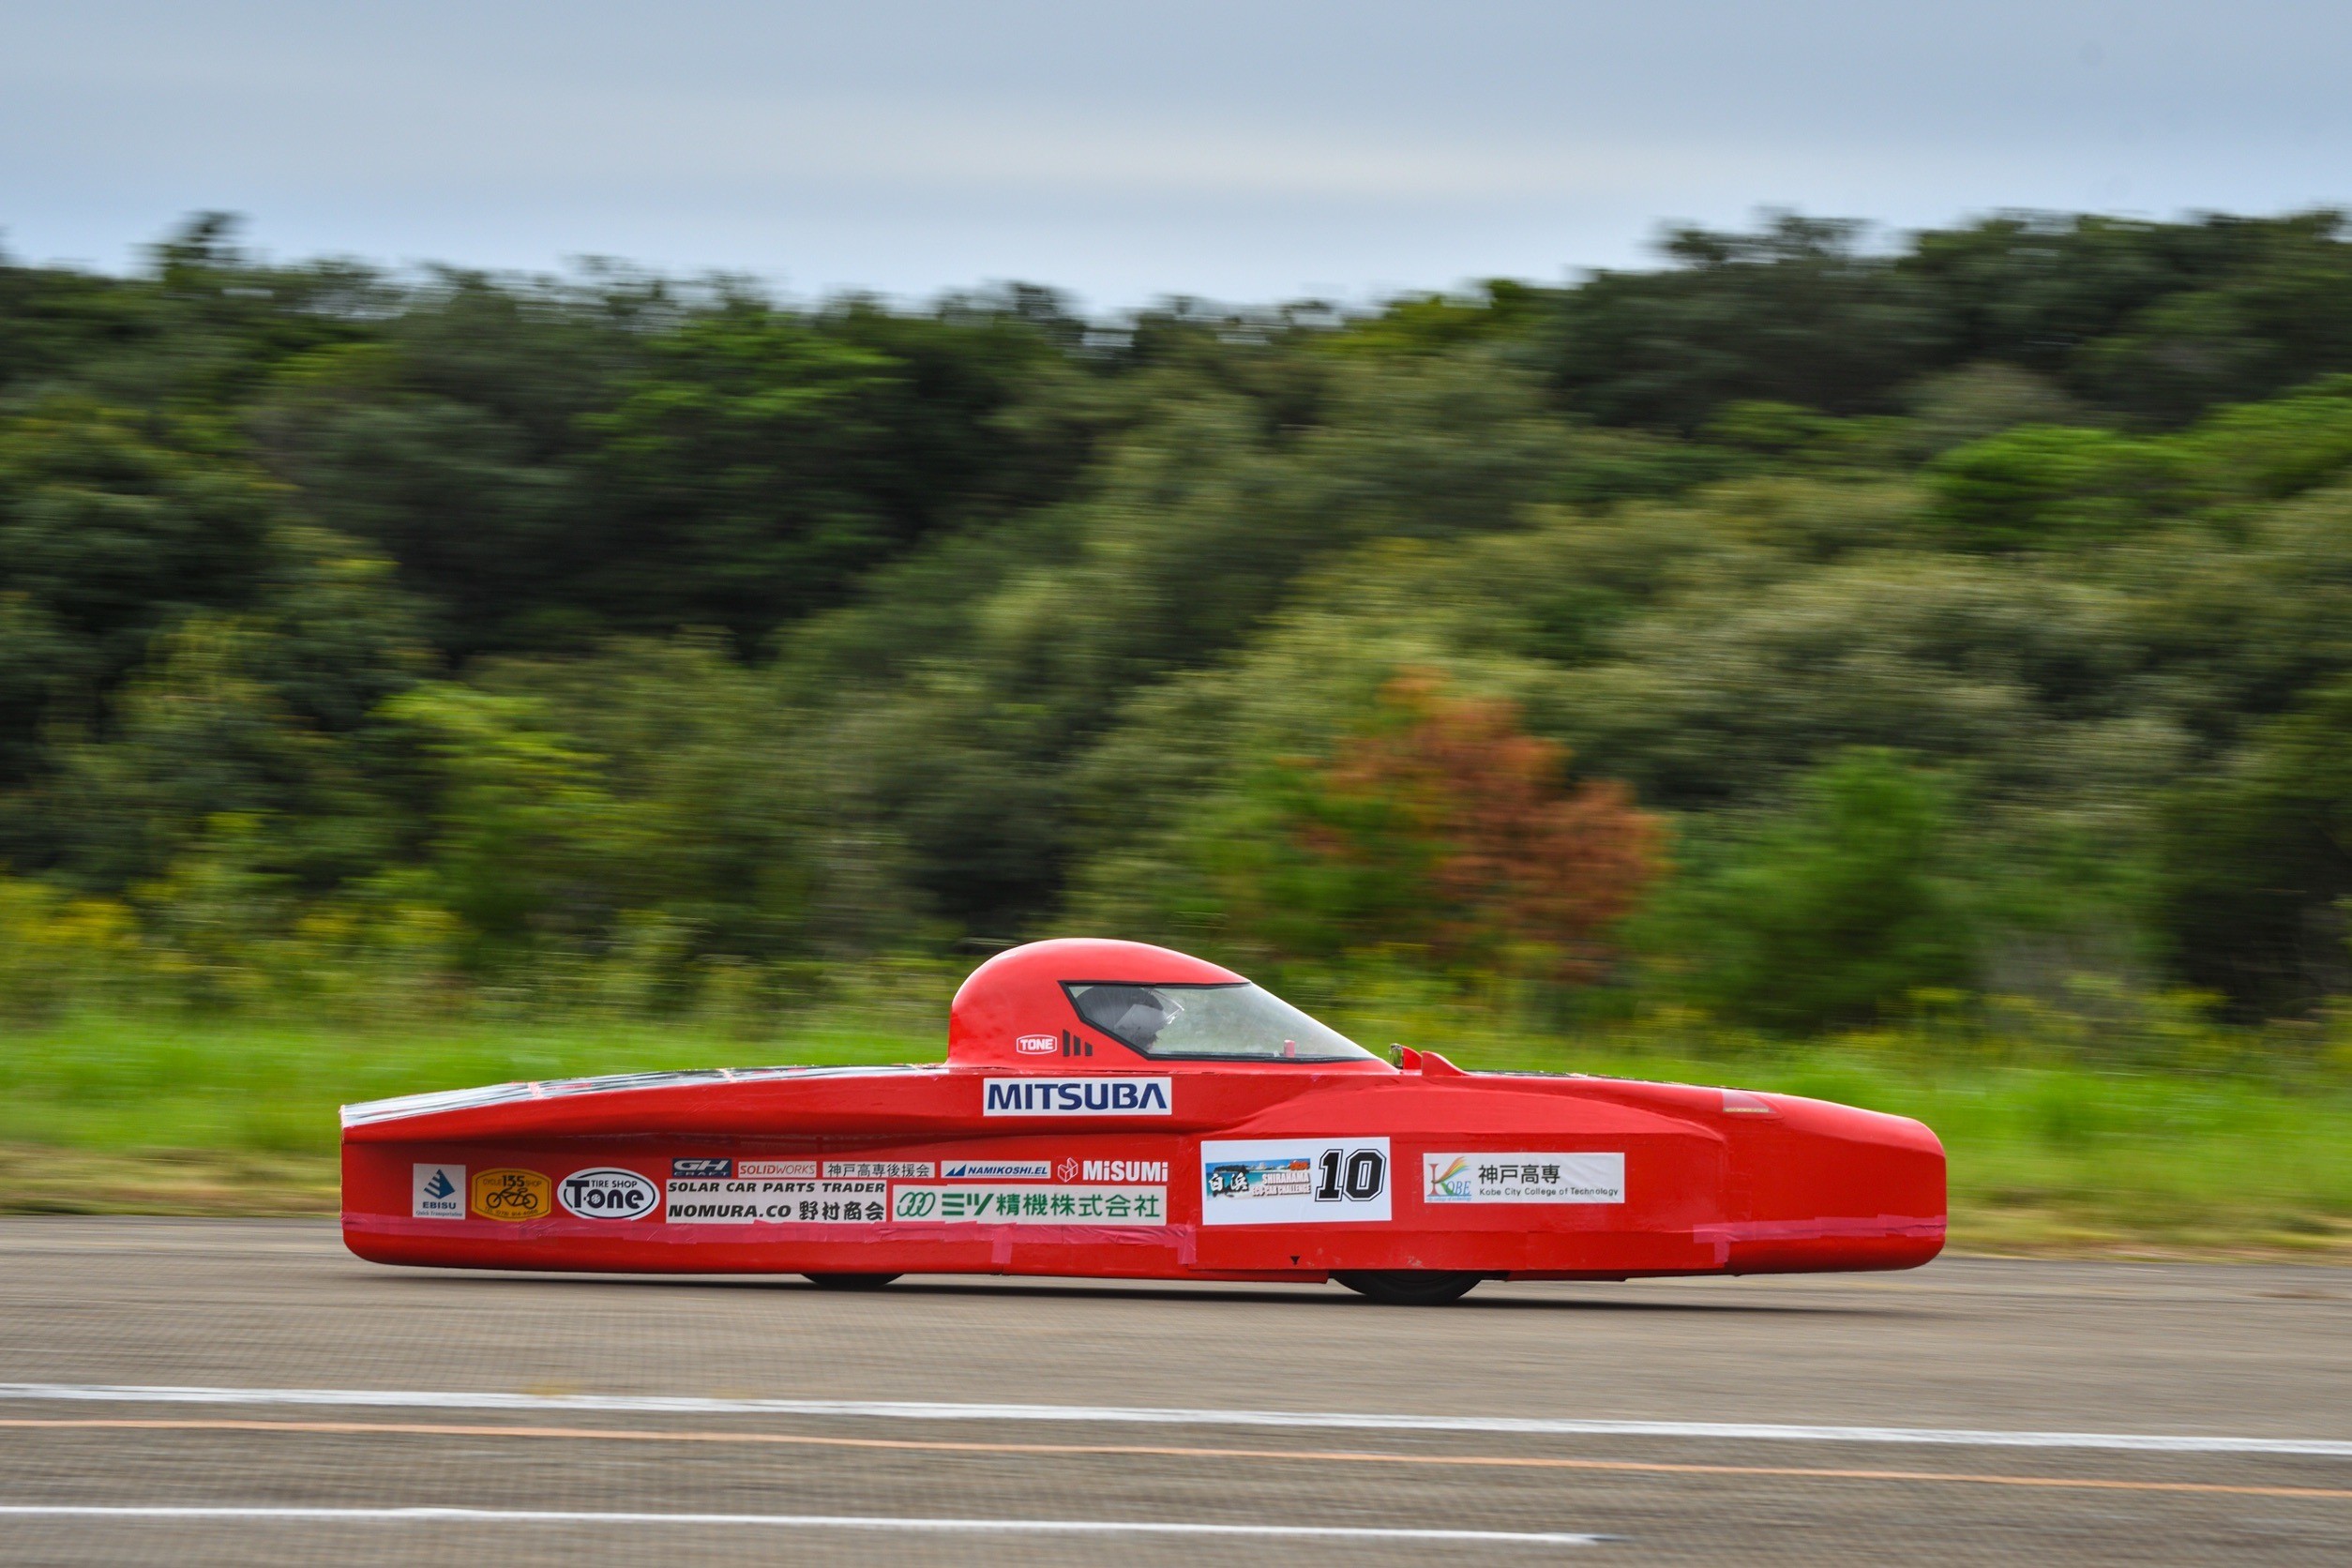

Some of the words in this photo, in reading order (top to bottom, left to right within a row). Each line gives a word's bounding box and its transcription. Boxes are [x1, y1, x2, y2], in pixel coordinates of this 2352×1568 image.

[1019, 1038, 1054, 1050] TONE
[988, 1082, 1167, 1110] MITSUBA
[673, 1159, 729, 1170] GH
[739, 1164, 815, 1175] SOLIDWORKS
[827, 1163, 930, 1178] 神戸高専後援会
[968, 1166, 1048, 1175] NAMIKOSHI.EL
[502, 1174, 525, 1187] 135
[1261, 1171, 1310, 1185] SHIRAHAMA
[1314, 1148, 1388, 1202] 10
[1478, 1164, 1560, 1184] 神戸高専
[591, 1180, 611, 1188] TIRE
[611, 1180, 638, 1188] SHOP
[668, 1183, 720, 1192] SOLAR
[726, 1183, 758, 1192] CAR
[762, 1183, 816, 1192] PARTS
[822, 1183, 885, 1193] TRADER
[1209, 1171, 1249, 1192] 白浜
[1479, 1187, 1502, 1196] Kobe
[1504, 1187, 1522, 1197] City
[1524, 1187, 1557, 1196] College
[1559, 1187, 1569, 1196] of
[1571, 1187, 1619, 1197] Technology
[422, 1201, 458, 1210] EBISU
[668, 1204, 792, 1218] NOMURA.CO
[799, 1200, 885, 1221] 野村商会
[941, 1192, 1161, 1218] ミツ精機株式会社
